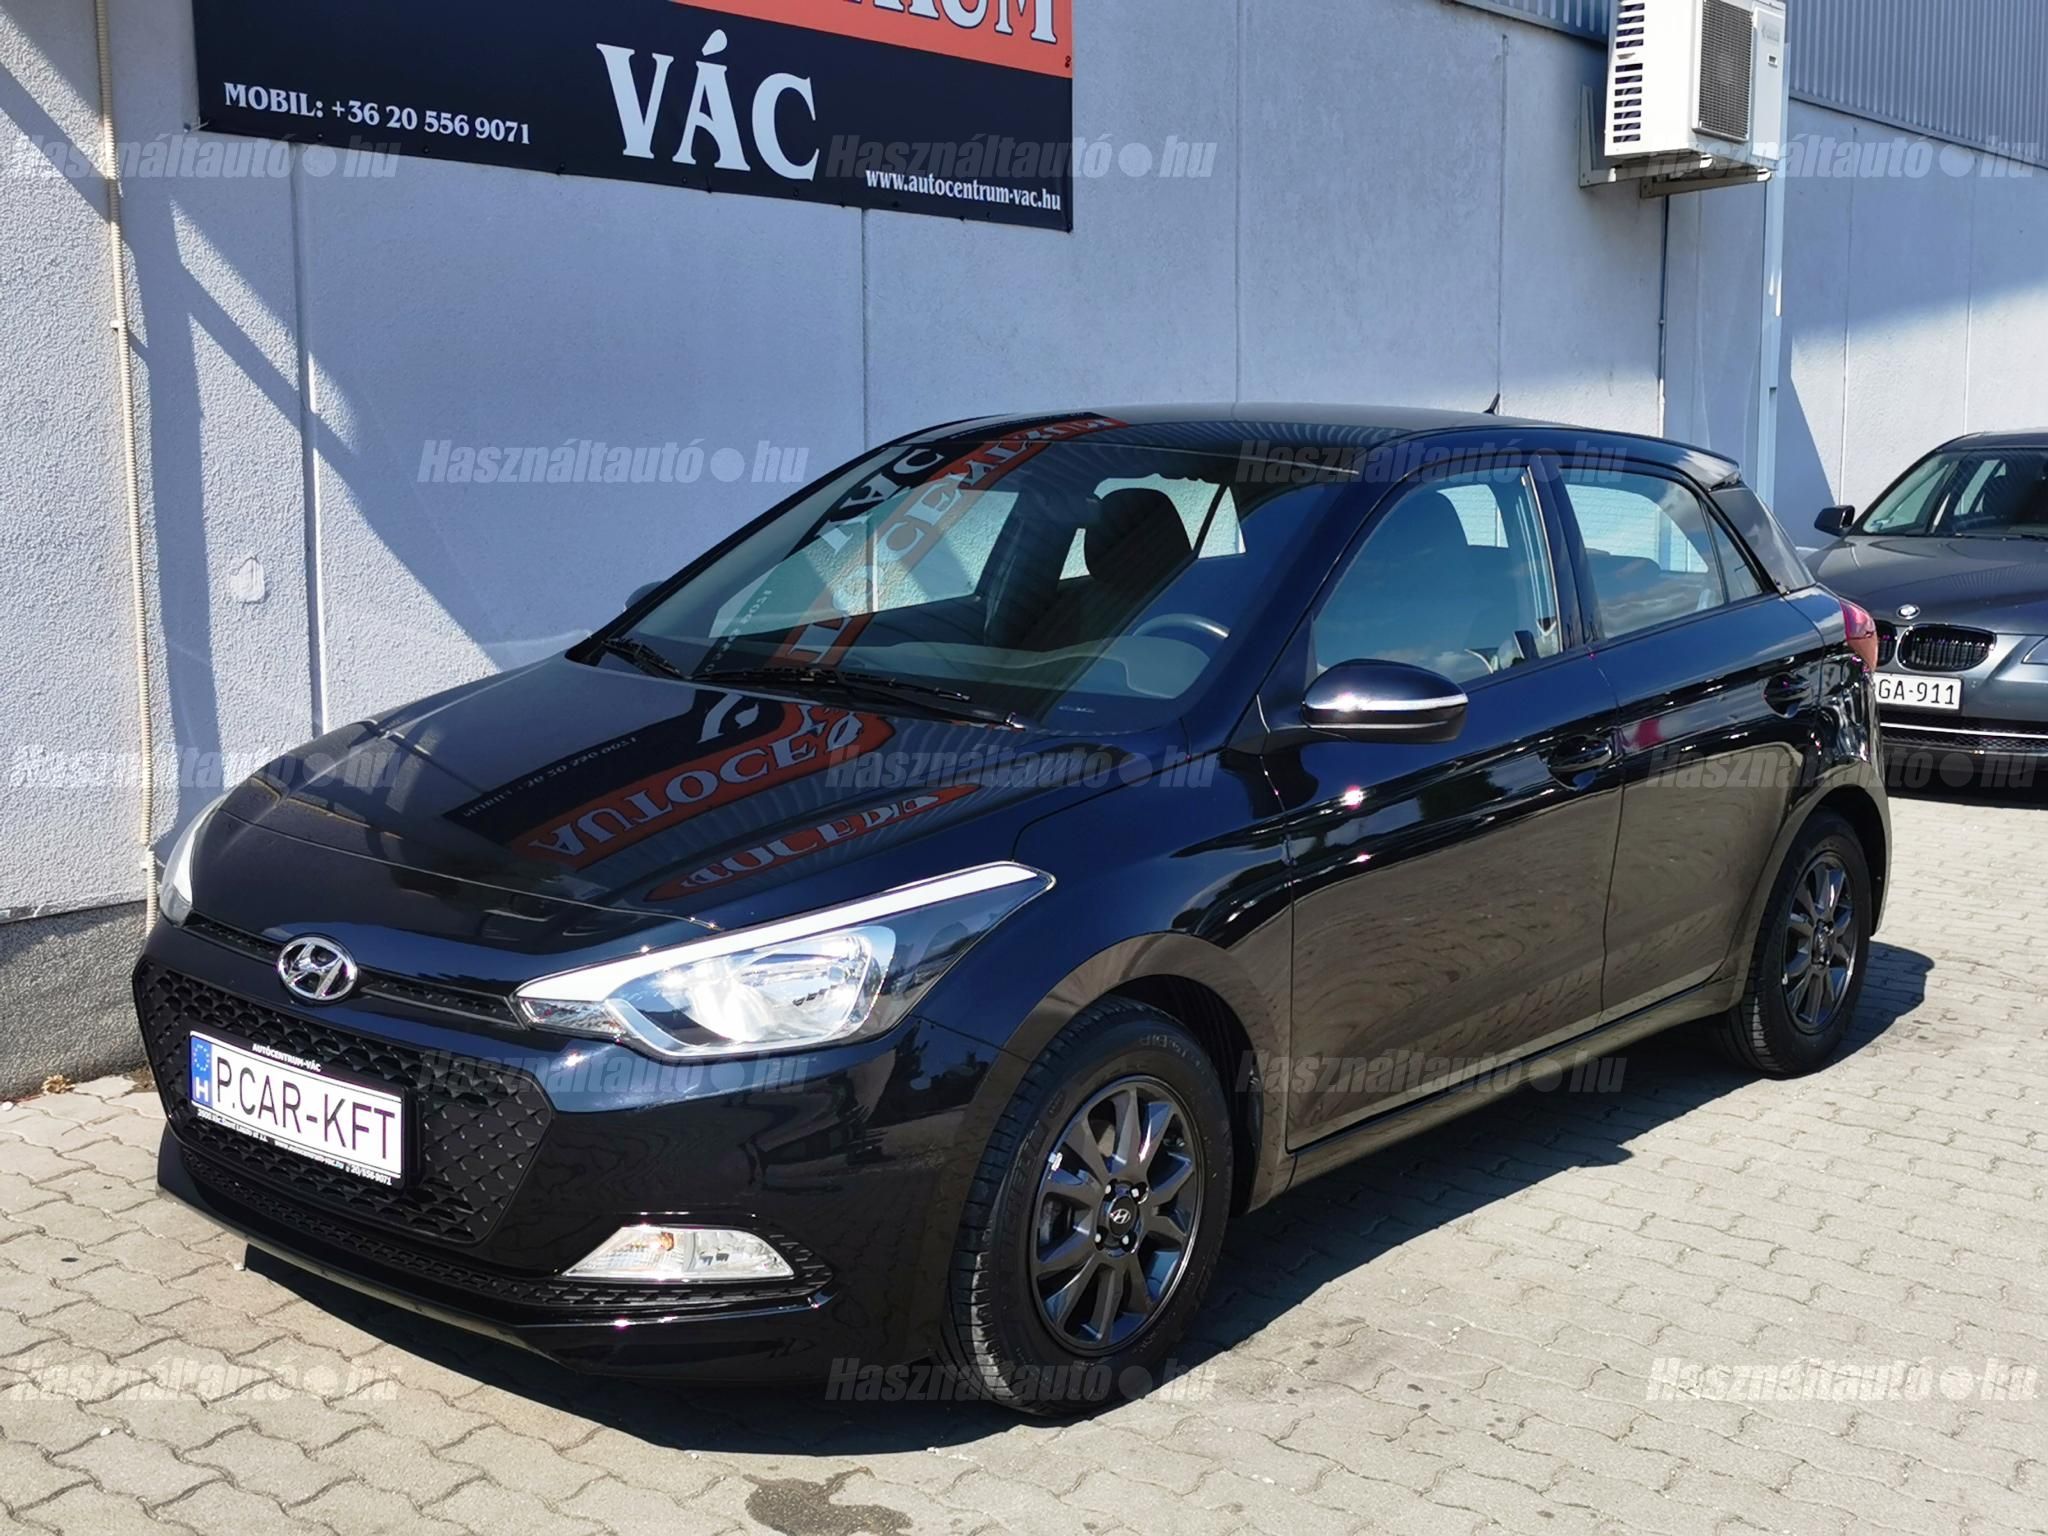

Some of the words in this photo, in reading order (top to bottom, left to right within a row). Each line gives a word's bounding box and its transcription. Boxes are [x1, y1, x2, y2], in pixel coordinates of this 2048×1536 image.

[224, 82, 323, 118] MOBIL:
[332, 100, 380, 126] +36
[386, 105, 417, 129] 20
[424, 110, 470, 137] 556
[475, 117, 530, 144] 9071
[596, 29, 819, 181] VÁC
[865, 168, 1061, 211] www.autocentrum-vac.hu
[1878, 679, 1955, 705] GA-911
[194, 1076, 209, 1103] H
